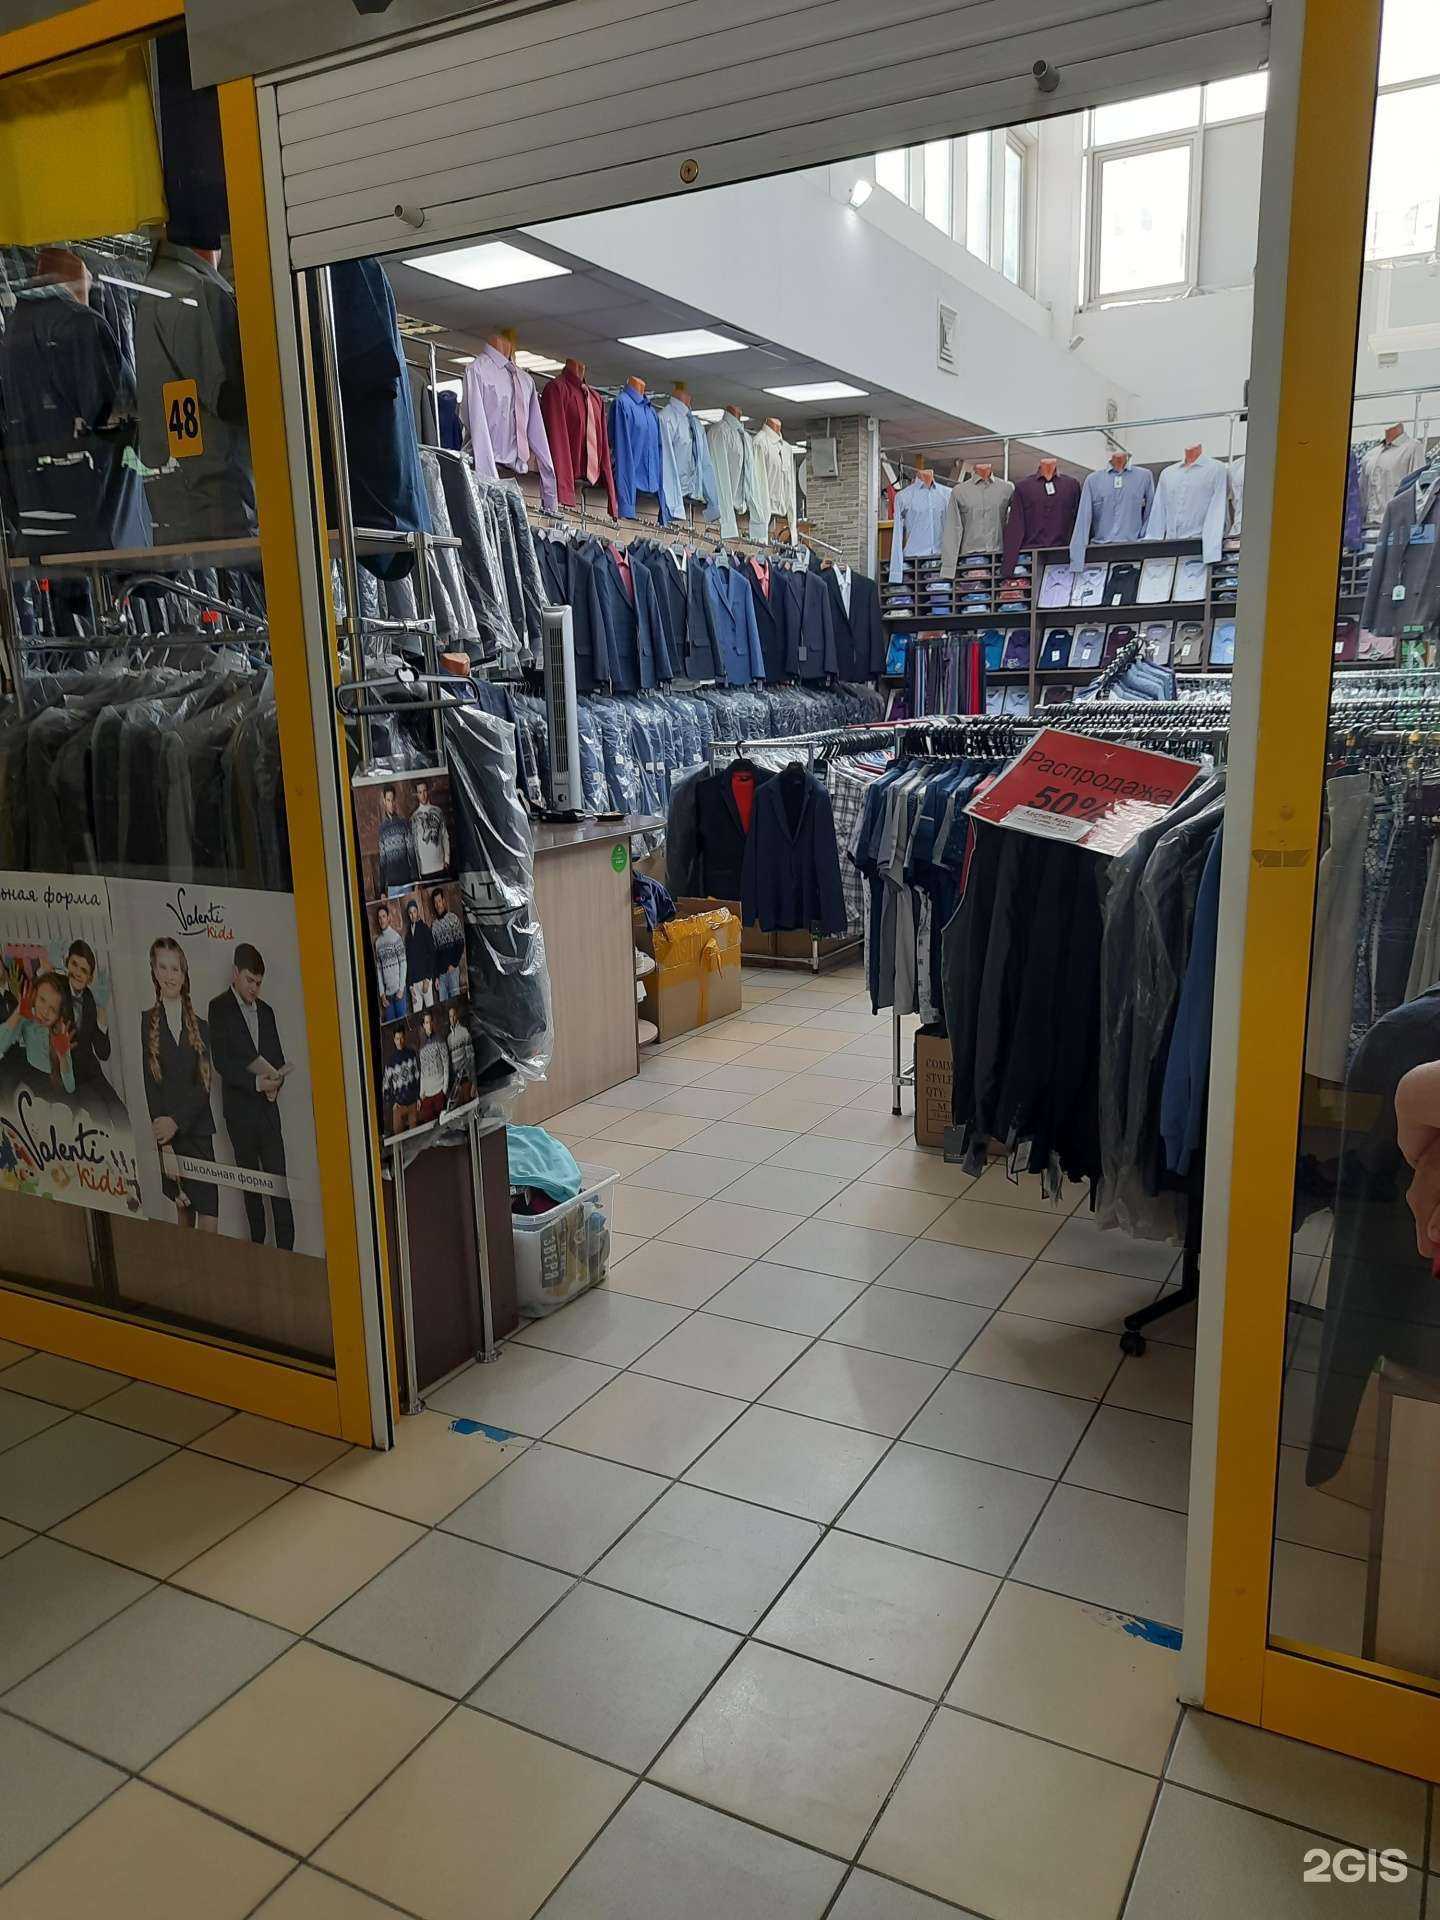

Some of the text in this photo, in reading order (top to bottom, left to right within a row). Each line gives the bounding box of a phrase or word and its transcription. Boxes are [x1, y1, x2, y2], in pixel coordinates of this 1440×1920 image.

[169, 397, 198, 440] 48
[1022, 751, 1174, 802] Распродажа
[43, 885, 102, 910] форма
[166, 887, 225, 931] Valenti
[0, 1090, 109, 1172] Valenti
[183, 1160, 274, 1189] Школьная форма
